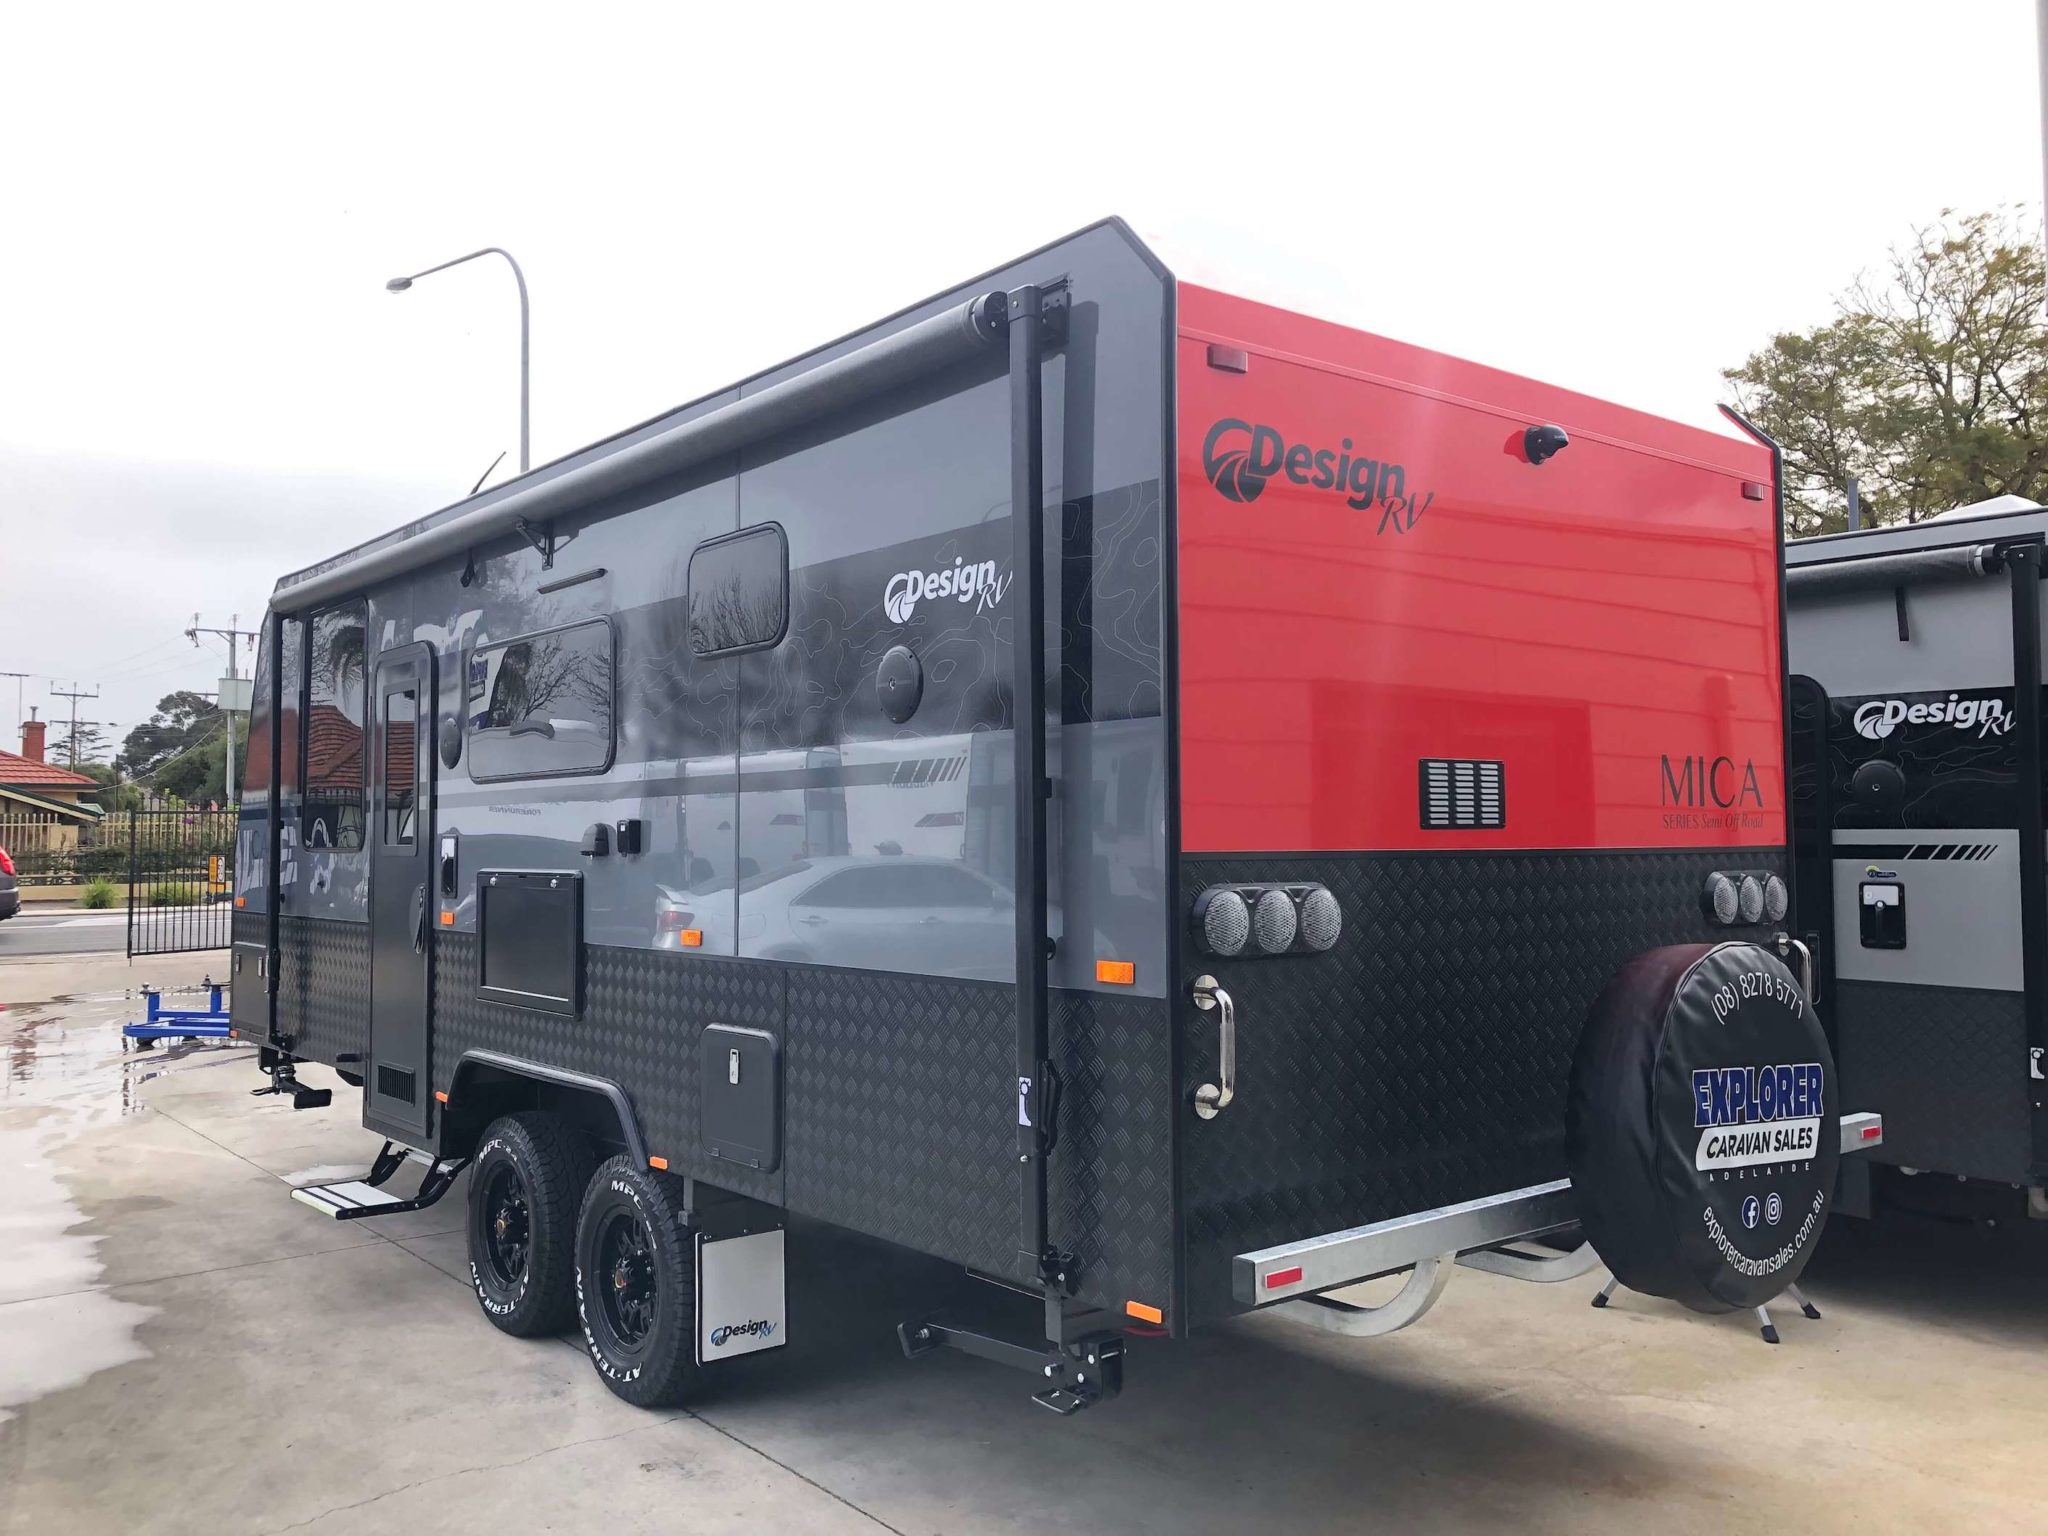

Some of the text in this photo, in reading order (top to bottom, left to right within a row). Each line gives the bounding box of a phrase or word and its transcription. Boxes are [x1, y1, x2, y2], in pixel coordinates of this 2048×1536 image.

[1247, 423, 1405, 511] Design
[1377, 491, 1435, 536] RV
[904, 556, 997, 603] Design
[976, 569, 1013, 615] RV
[1882, 693, 2004, 729] Design
[1661, 754, 1764, 808] MICA
[1663, 813, 1699, 830] SERIES
[1725, 812, 1741, 832] Off
[1711, 972, 1803, 1025] (08) 8278 5771
[1692, 1063, 1824, 1128] EXPLORER
[1706, 1126, 1813, 1159] CARAVAN SALES
[1709, 1162, 1810, 1183] ADELAIDE
[1703, 1189, 1825, 1276] explorercaravansales.com.au
[722, 1319, 768, 1338] Design
[758, 1321, 777, 1340] RV
